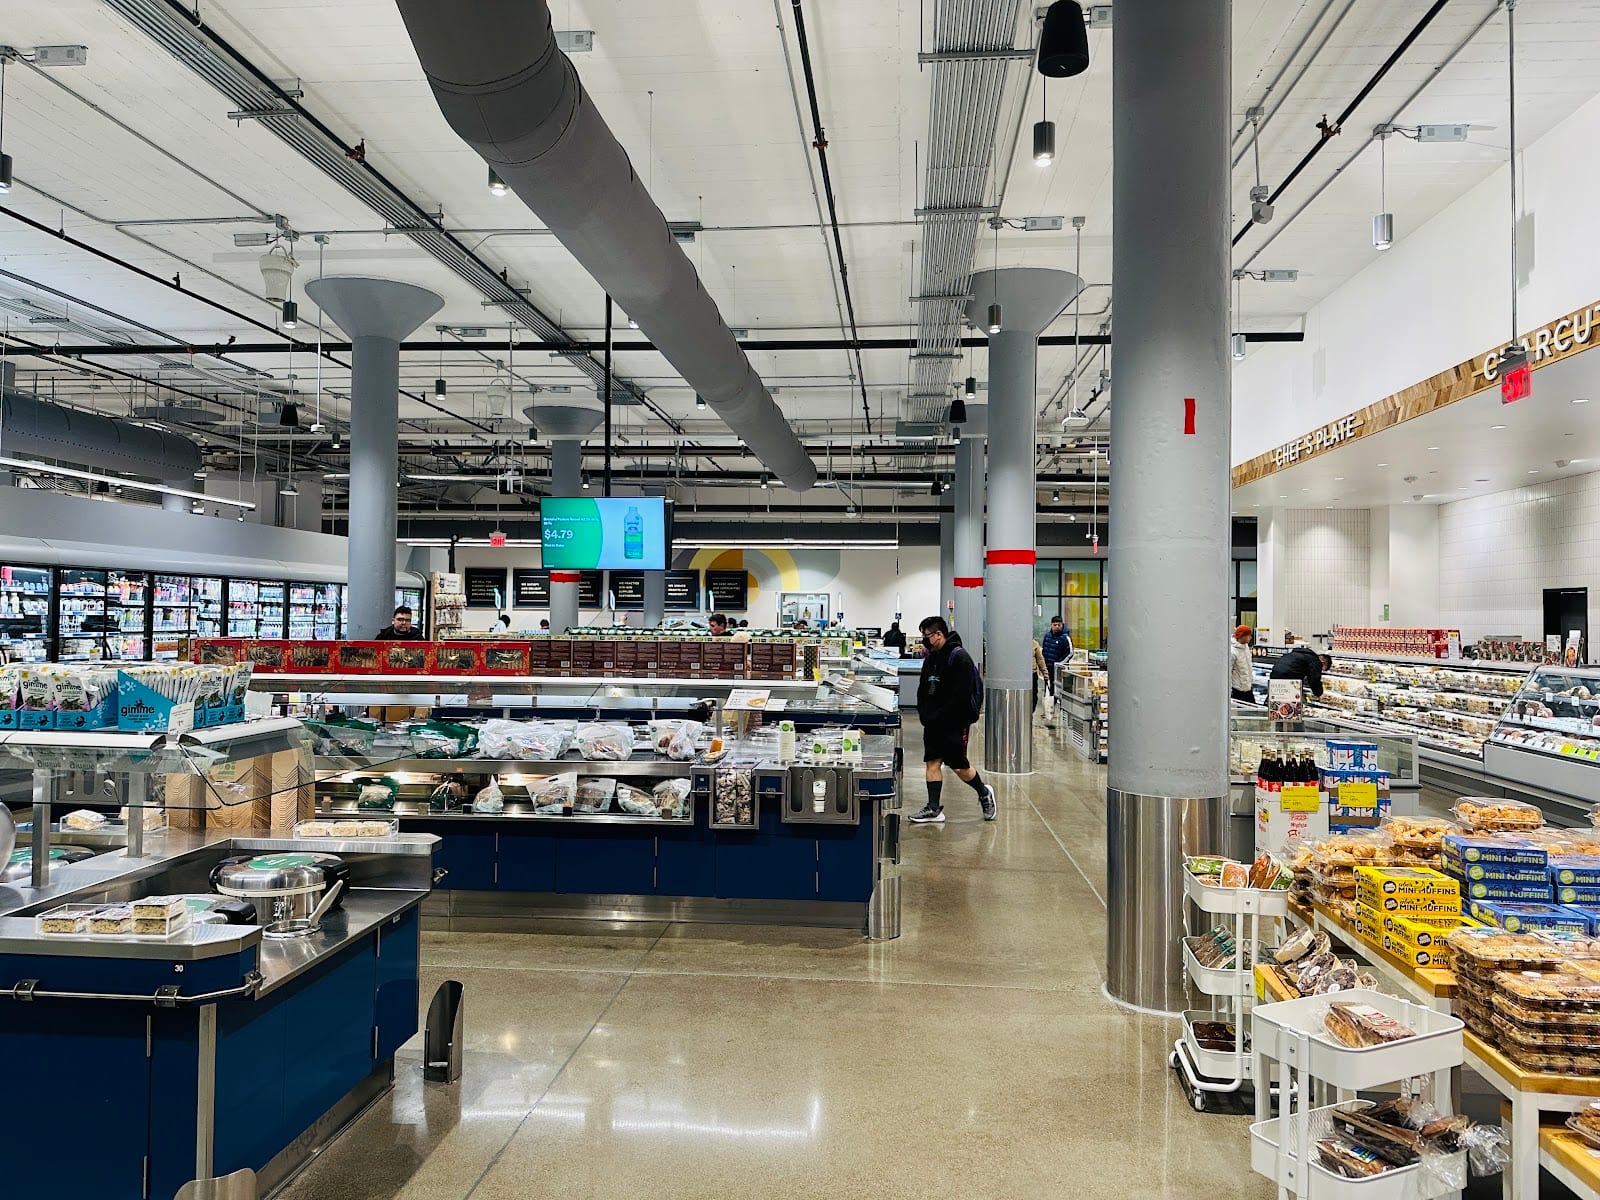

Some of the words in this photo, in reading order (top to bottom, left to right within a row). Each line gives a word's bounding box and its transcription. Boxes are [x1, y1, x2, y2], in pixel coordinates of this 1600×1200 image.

[1276, 435, 1313, 466] CHEF'S
[1316, 415, 1356, 451] PLATE
[544, 528, 573, 540] $4.79
[23, 680, 48, 689] gimme
[56, 683, 82, 692] gimme
[121, 704, 155, 716] gimme
[1481, 854, 1501, 862] MINI
[1503, 856, 1545, 864] MUFFINS
[1485, 872, 1505, 880] MINI
[1507, 874, 1547, 882] MUFFINS
[1419, 887, 1456, 895] MUFFINS
[1488, 889, 1507, 898] MINI
[1510, 891, 1550, 900] MUFFINS
[1420, 904, 1458, 912] MUFFINS
[174, 964, 184, 973] 30
